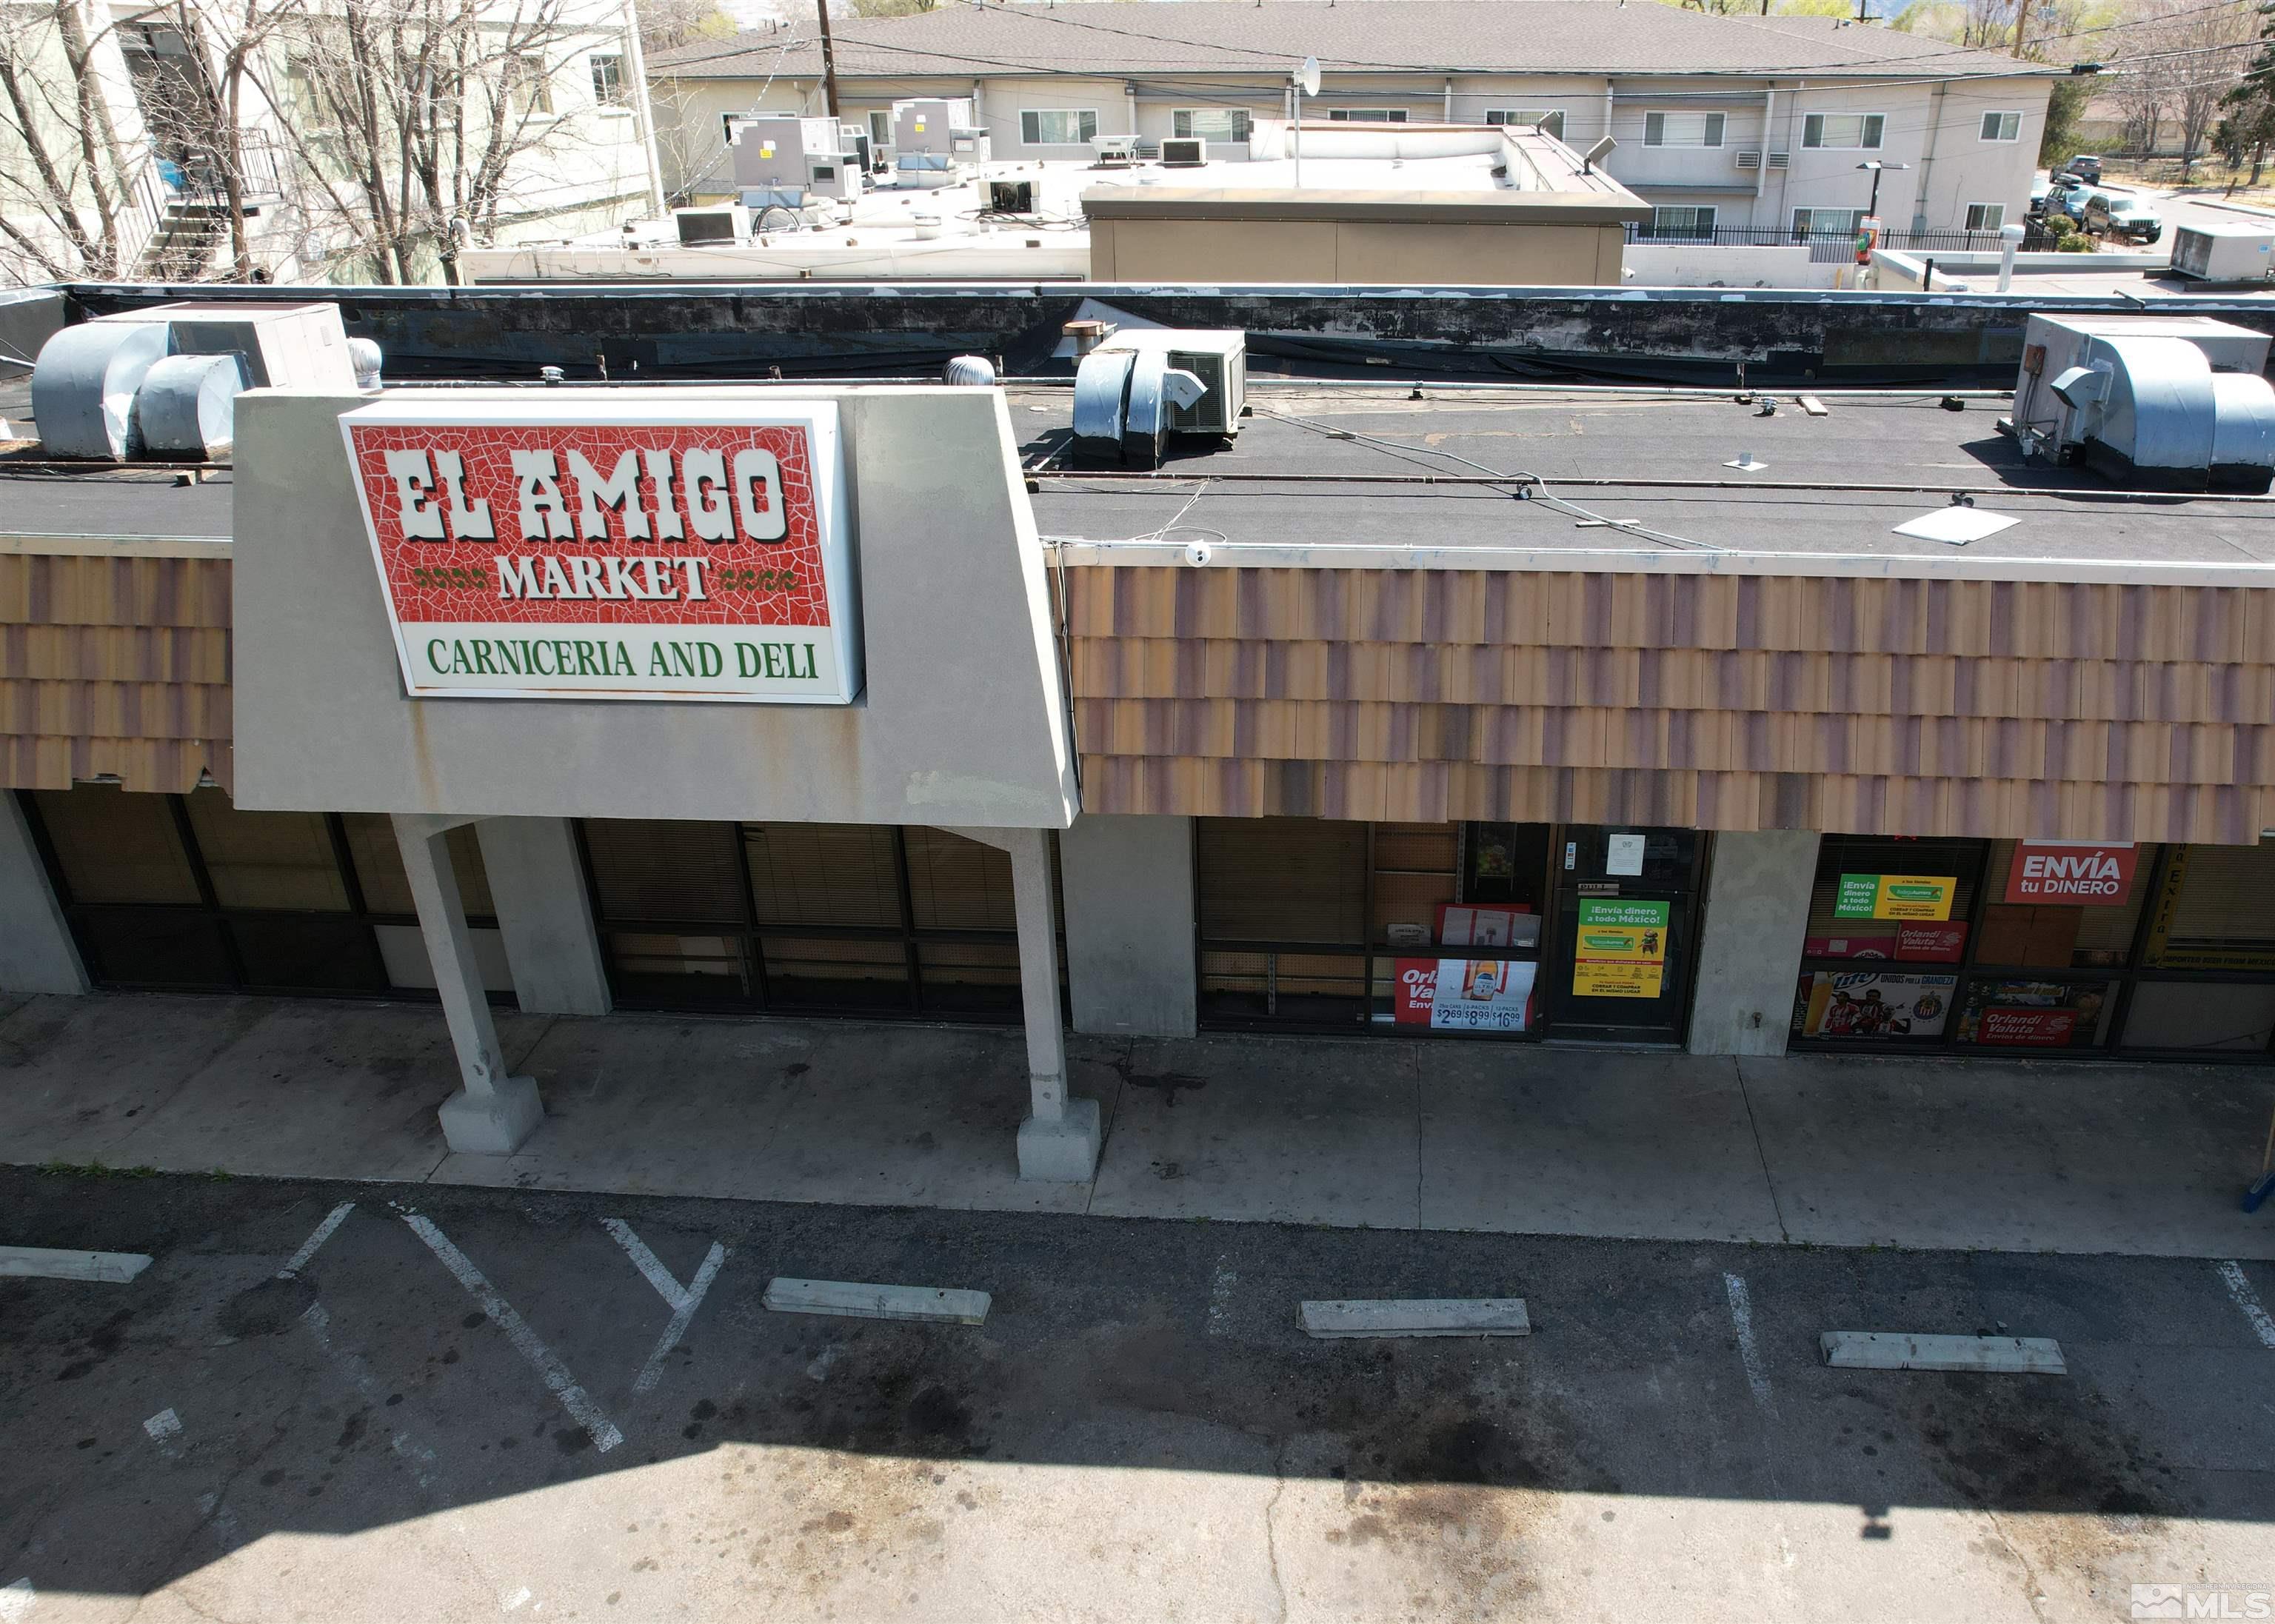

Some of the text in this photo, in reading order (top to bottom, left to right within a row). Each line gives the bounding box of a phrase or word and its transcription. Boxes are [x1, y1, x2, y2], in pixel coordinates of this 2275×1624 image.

[384, 447, 789, 544] EL AMIGO
[494, 555, 713, 601] MARKET
[426, 638, 820, 680] CARNICERIA AND DELI
[2022, 850, 2121, 880] ENVÍA
[2020, 879, 2119, 895] tu DINERO
[1624, 906, 1657, 915] dinero
[1838, 903, 1873, 912] México!
[1618, 915, 1660, 924] México!
[1901, 929, 1942, 938] Orlandi
[1902, 937, 1936, 945] Valuta
[1880, 975, 1905, 983] UNIDOS
[1921, 976, 1954, 985] GRANDEZA
[1409, 1000, 1432, 1009] Env
[1986, 1014, 2044, 1025] Orlandi
[1988, 1023, 2034, 1034] Valuta
